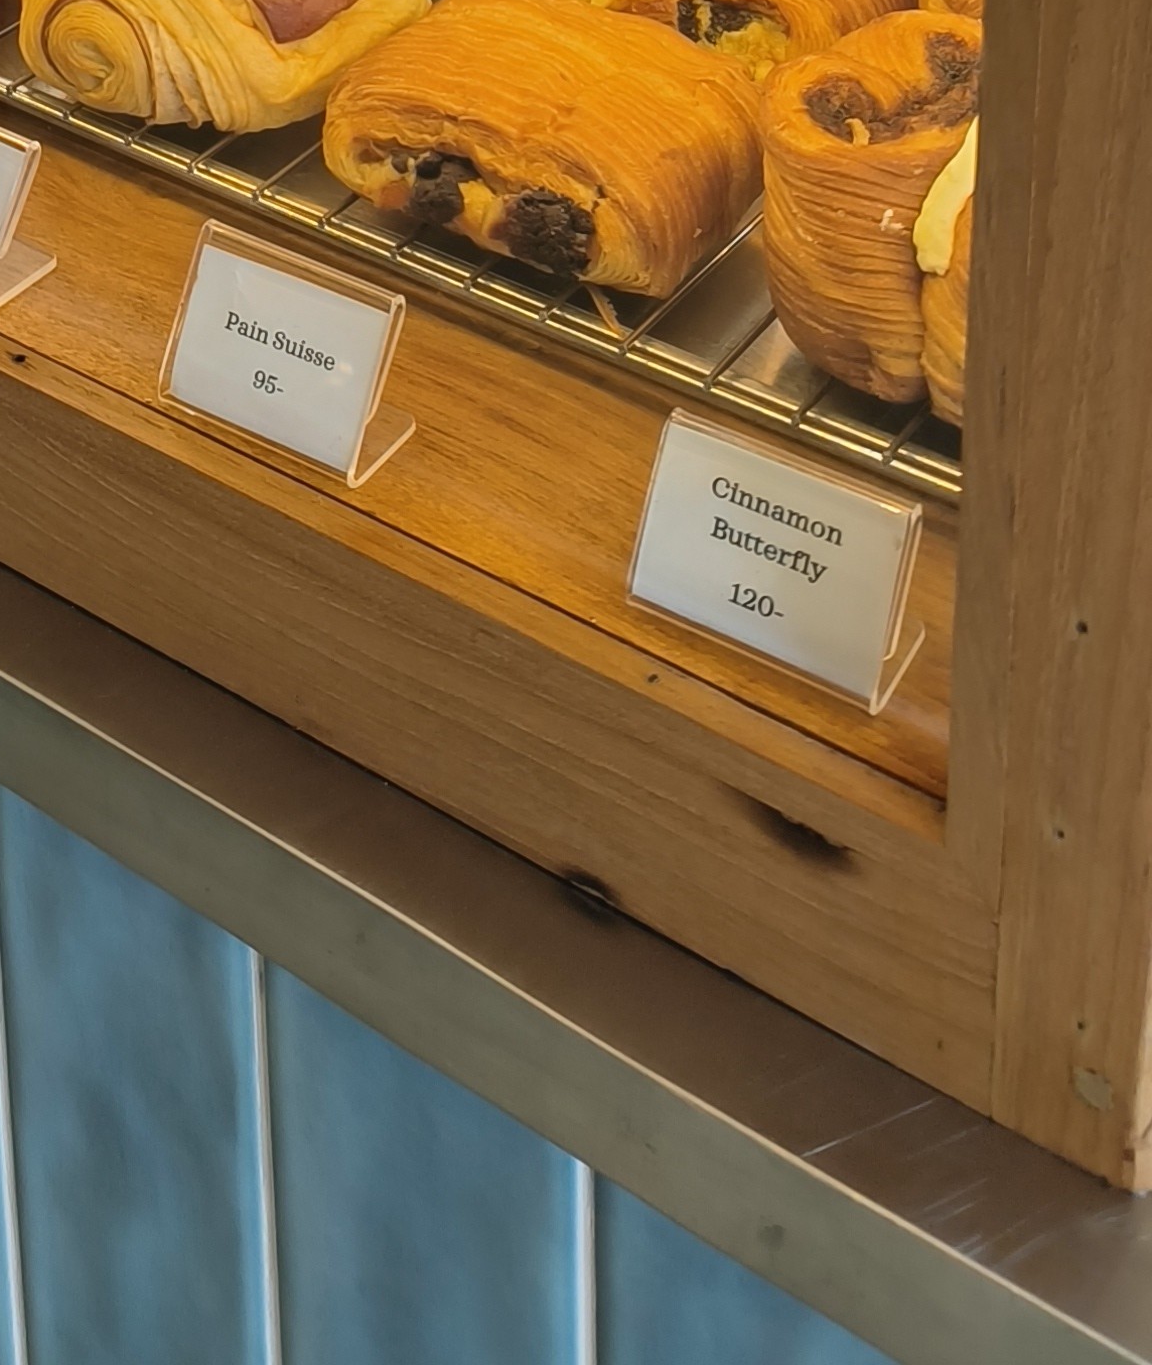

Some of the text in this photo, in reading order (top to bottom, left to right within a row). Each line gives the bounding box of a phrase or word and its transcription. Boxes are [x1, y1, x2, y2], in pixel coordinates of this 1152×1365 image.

[224, 311, 336, 371] Pain Suisse
[252, 370, 284, 394] 95-
[711, 477, 843, 546] Cinnamon
[710, 516, 828, 584] Butterfly
[727, 583, 785, 618] 120-
